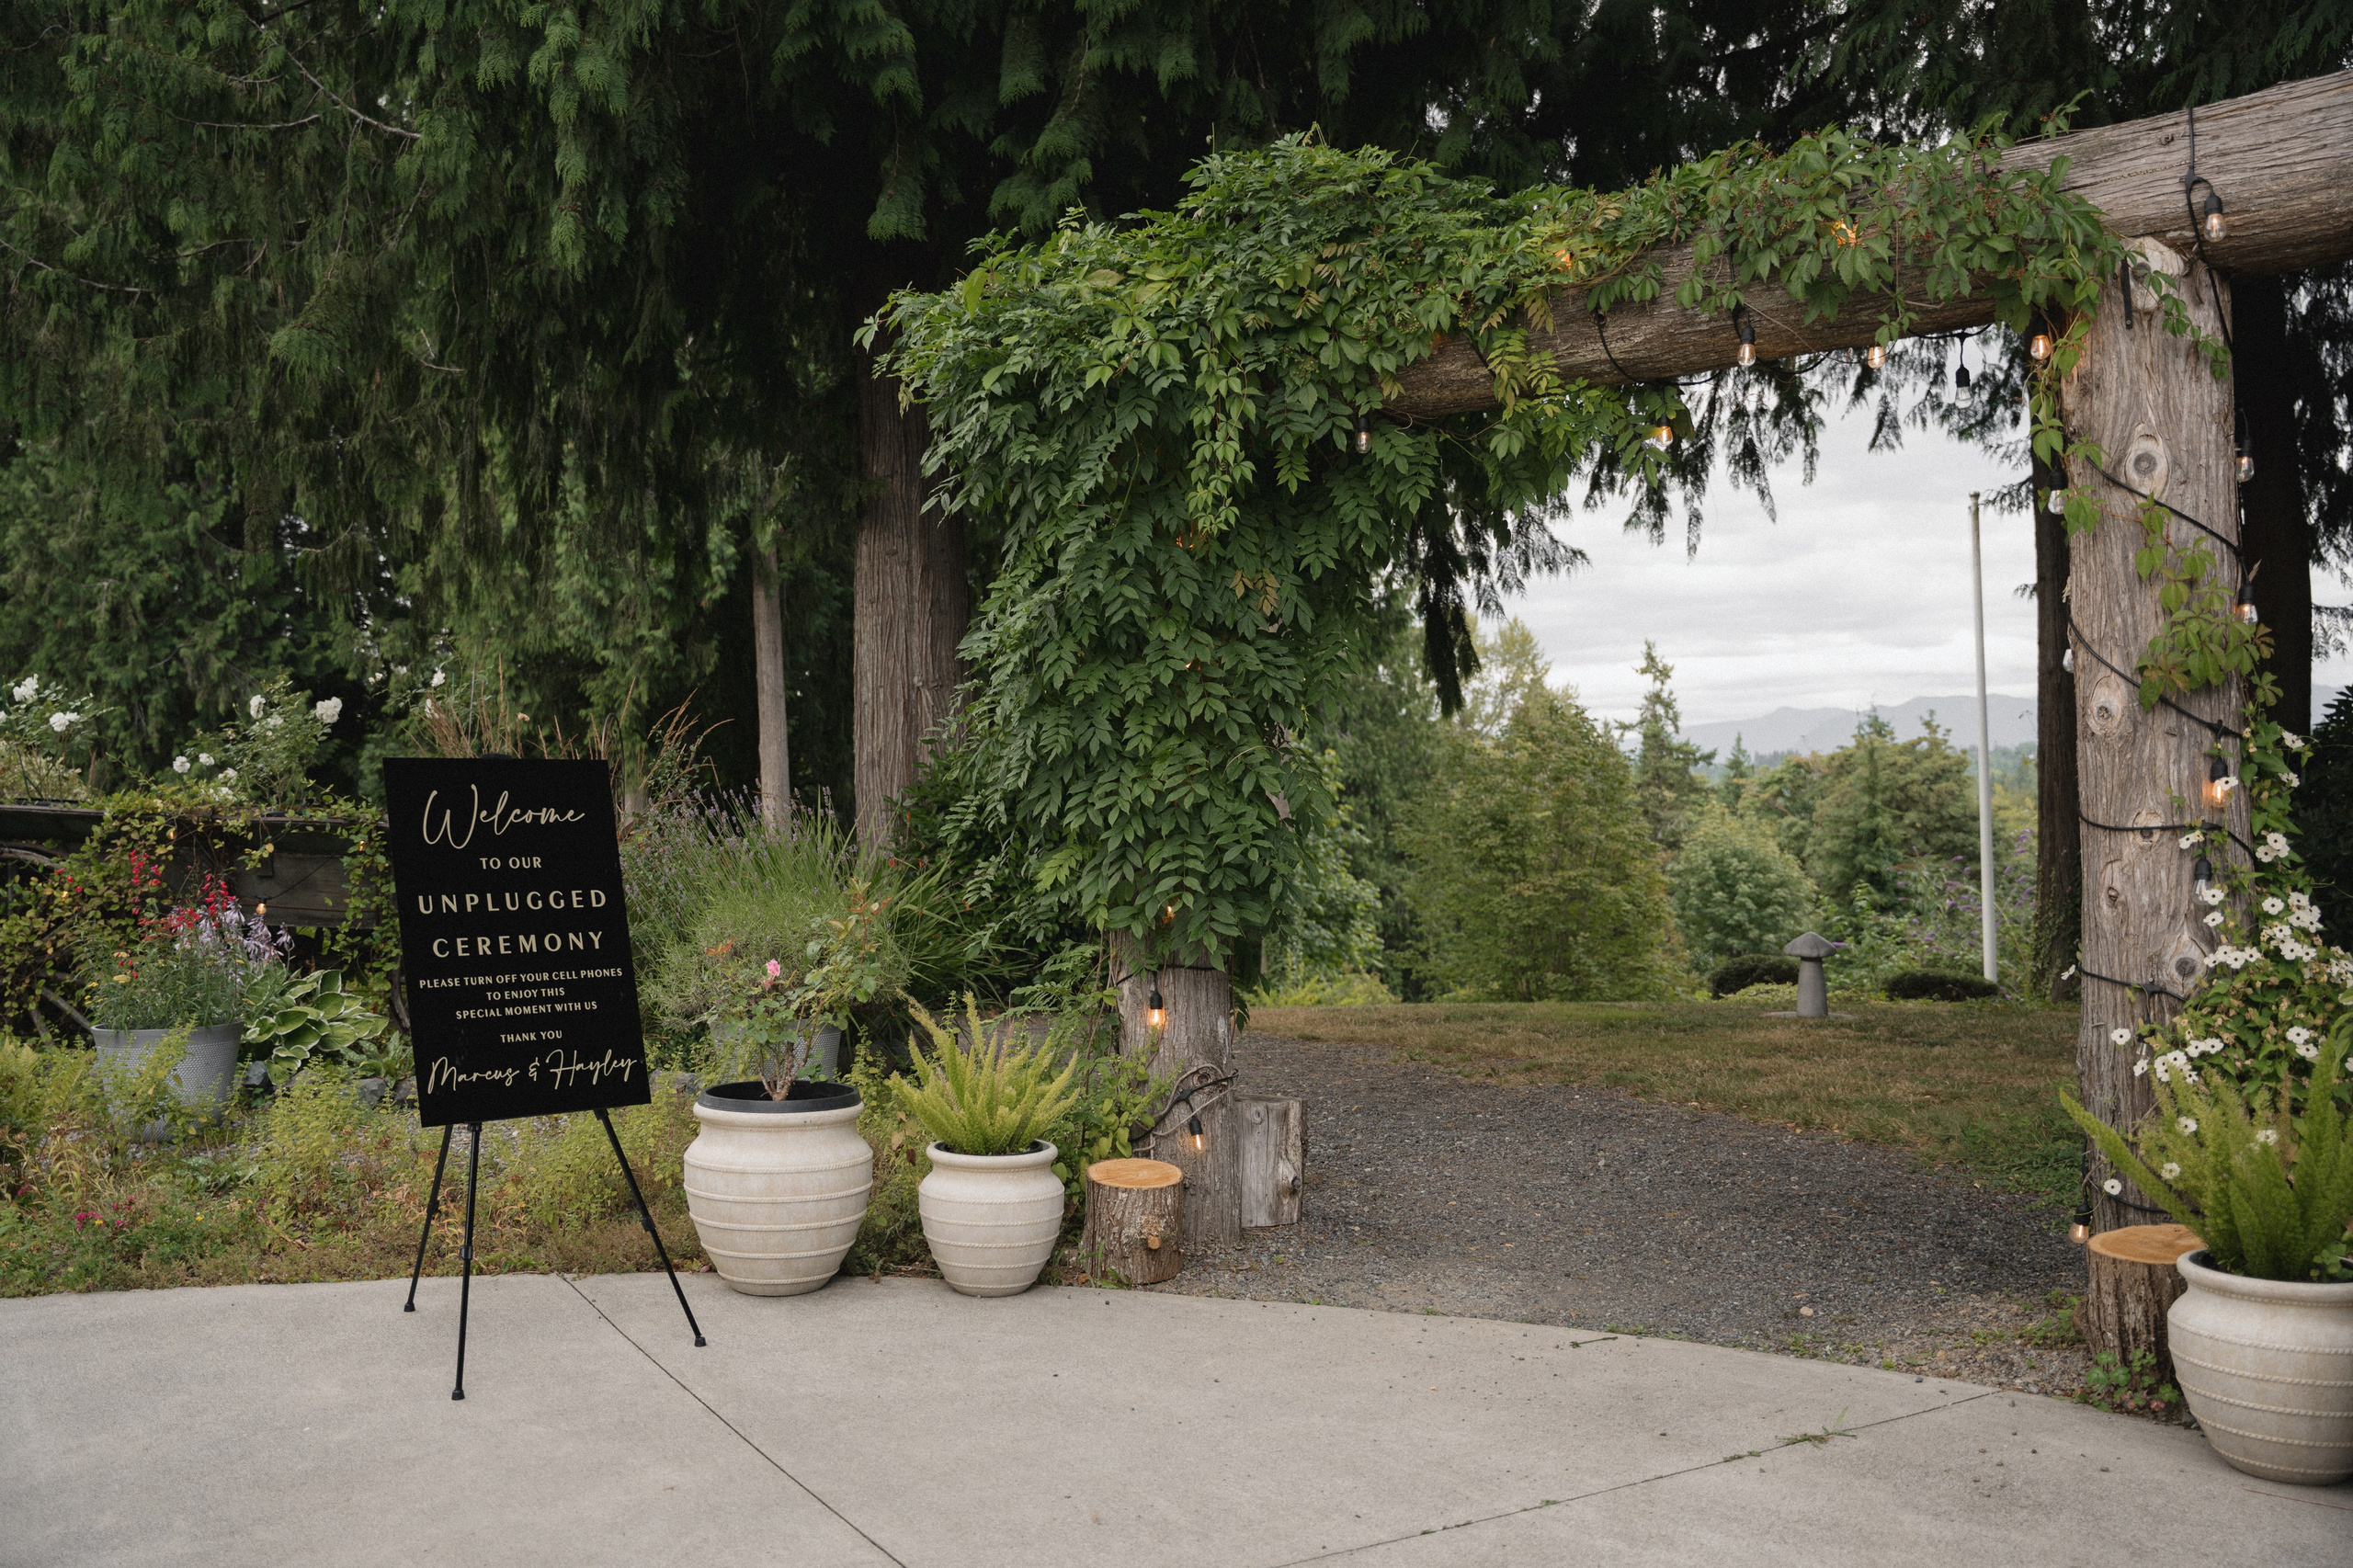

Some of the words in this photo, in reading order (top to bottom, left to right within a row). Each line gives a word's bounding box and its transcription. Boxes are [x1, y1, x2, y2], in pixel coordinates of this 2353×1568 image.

[422, 783, 585, 849] Welcome
[479, 857, 501, 869] TO
[508, 856, 542, 869] OUR
[417, 889, 607, 915] UNPLUGGED
[432, 930, 603, 959] CEREMONY
[419, 977, 461, 989] PLEASE
[462, 975, 493, 986] TURN
[495, 973, 517, 984] OFF
[519, 971, 550, 983] YOUR
[551, 971, 578, 981] CELL
[580, 967, 623, 979] PHONES
[485, 991, 502, 1001] TO
[504, 989, 539, 1000] ENJOY
[540, 986, 565, 997] THIS
[455, 1007, 503, 1020] SPECIAL
[505, 1004, 552, 1017] MOMENT
[553, 1002, 582, 1013] WITH
[584, 1000, 597, 1011] US
[499, 1031, 537, 1043] THANK
[540, 1029, 563, 1040] YOU
[427, 1056, 520, 1095] Marcus
[528, 1056, 540, 1082] &
[545, 1049, 638, 1090] Hayley
